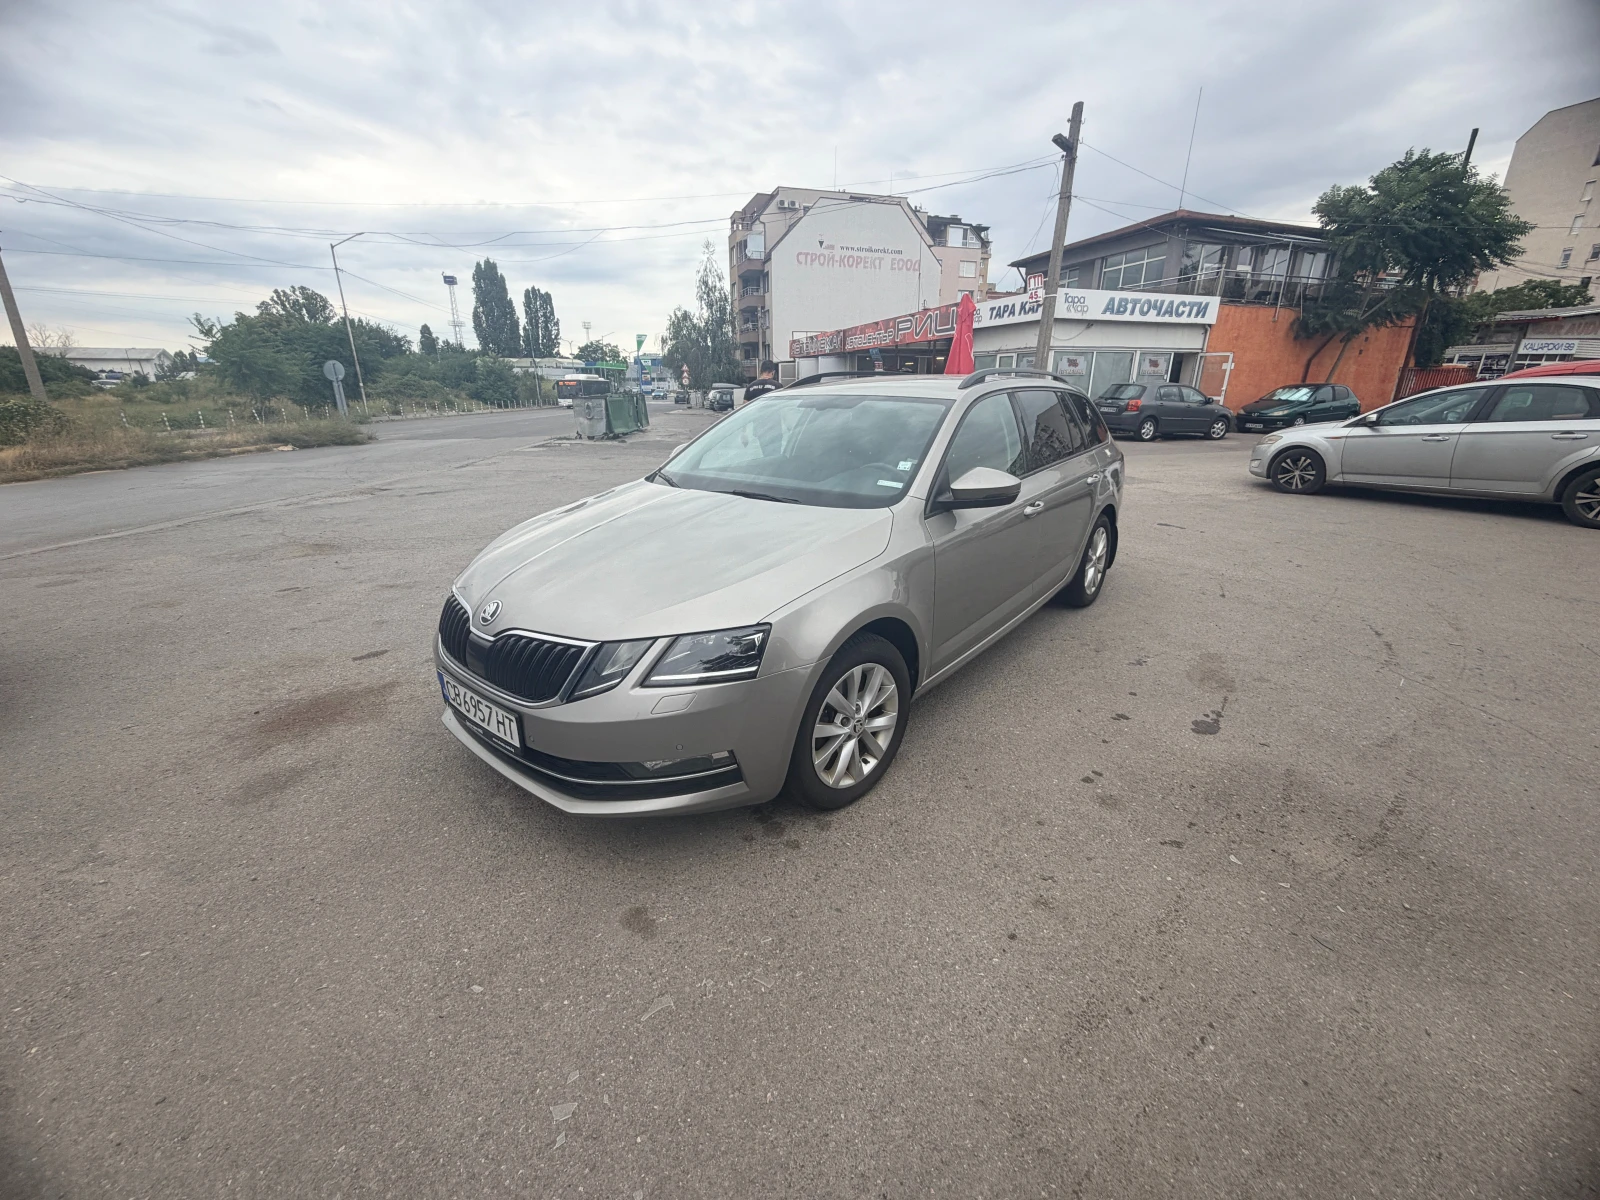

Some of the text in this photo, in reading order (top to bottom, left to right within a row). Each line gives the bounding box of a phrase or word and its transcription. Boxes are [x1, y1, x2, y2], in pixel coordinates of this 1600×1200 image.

[840, 245, 903, 255] www.stroikorekt.com
[796, 251, 921, 272] СТРОЙ-КОРЕКТ ЕООД
[989, 303, 1016, 320] ТАРА
[1101, 296, 1210, 319] АВТОЧАСТИ
[446, 680, 462, 707] CB
[463, 691, 493, 727] 6957
[496, 710, 514, 740] HT
